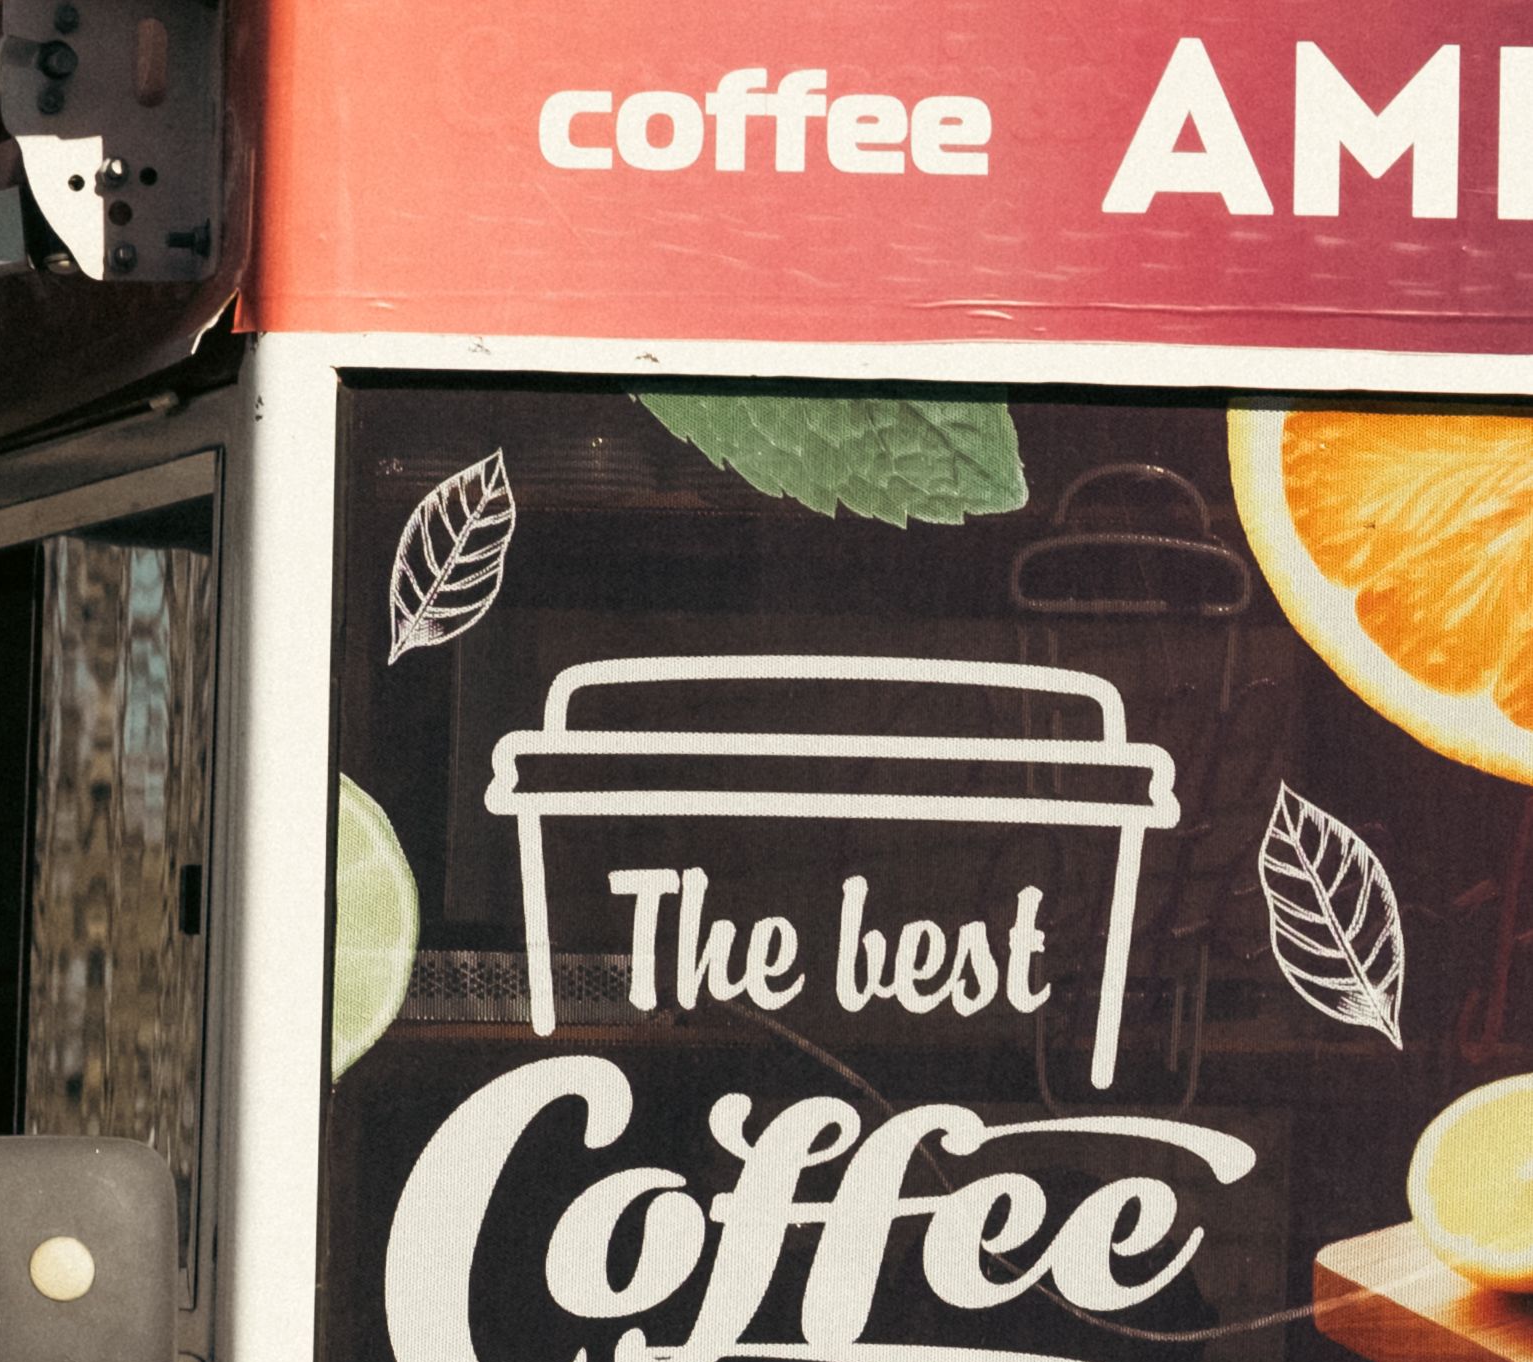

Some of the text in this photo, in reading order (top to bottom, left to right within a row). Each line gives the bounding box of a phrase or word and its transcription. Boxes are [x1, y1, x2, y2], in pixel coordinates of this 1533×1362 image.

[538, 67, 992, 176] coffee
[608, 867, 1051, 1017] The best
